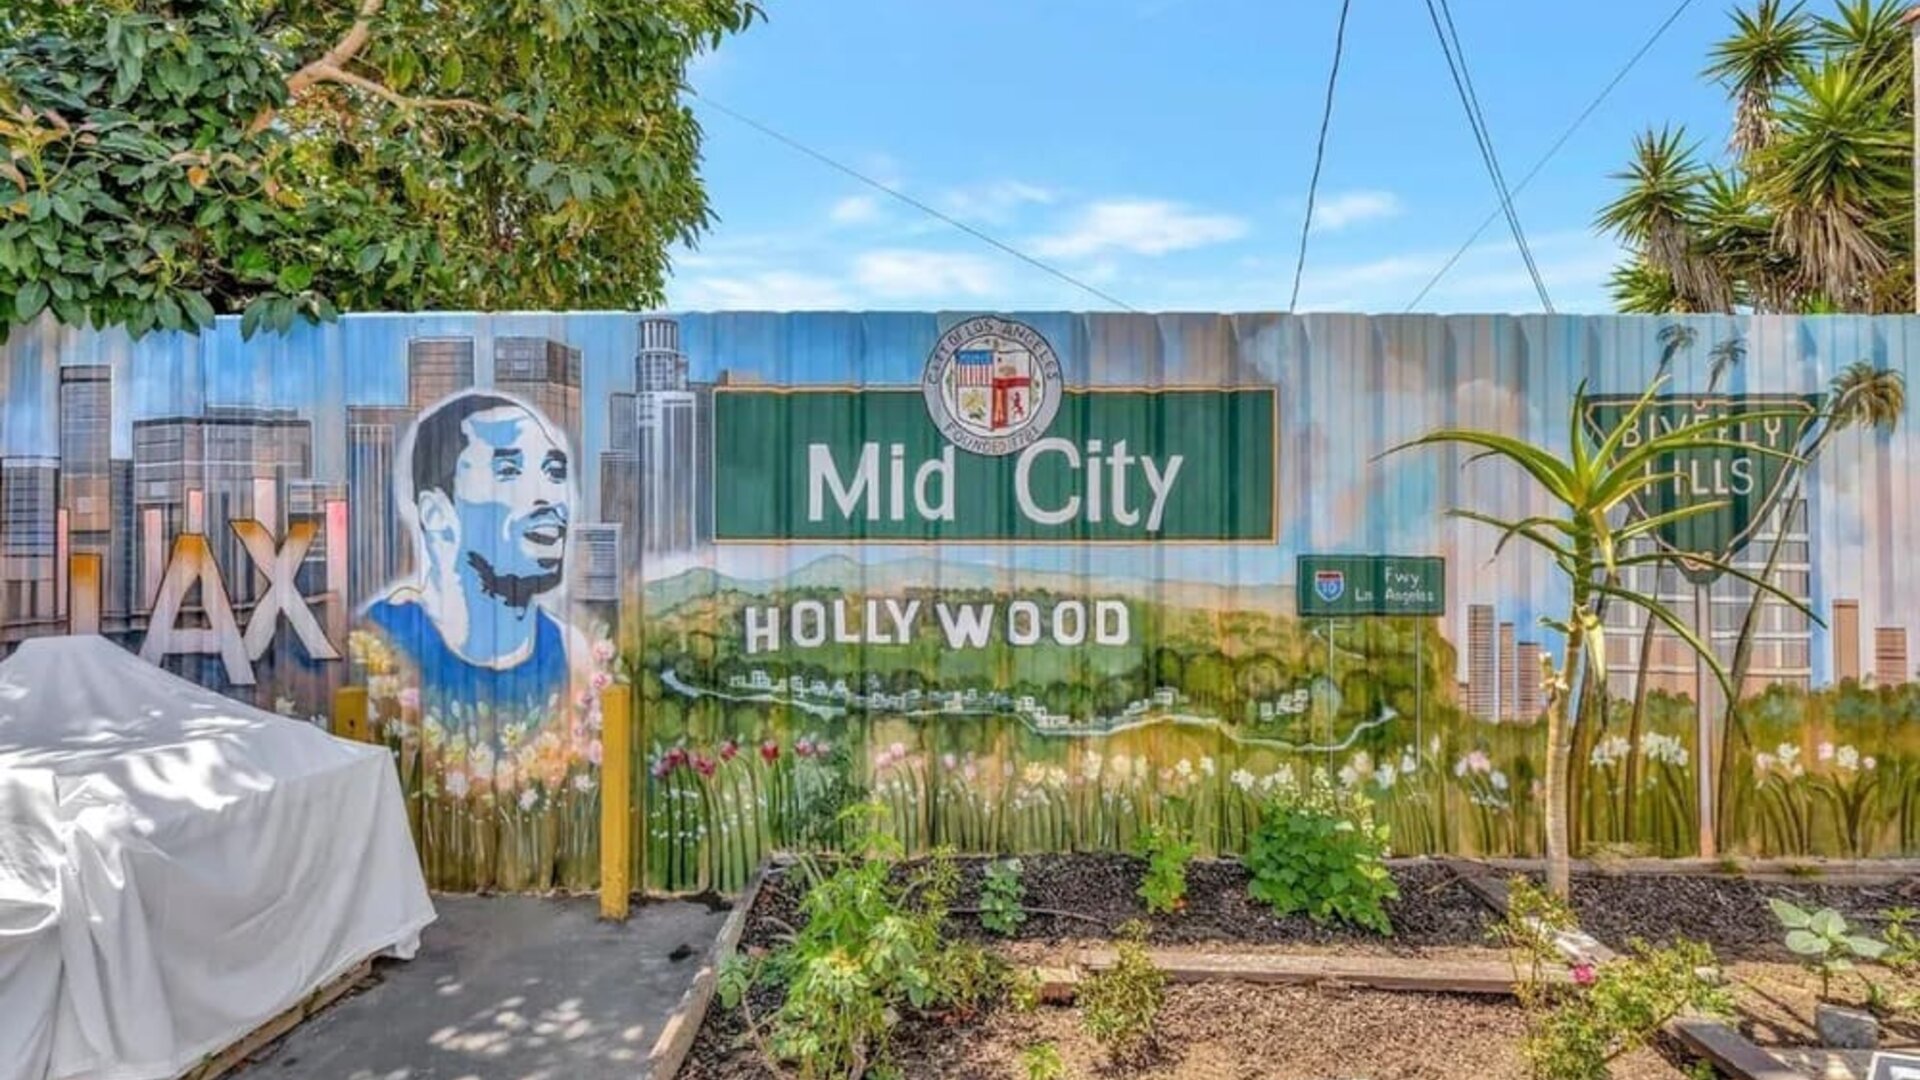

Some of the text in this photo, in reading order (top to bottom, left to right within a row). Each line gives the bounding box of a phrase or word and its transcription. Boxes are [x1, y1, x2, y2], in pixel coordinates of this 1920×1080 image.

[965, 321, 993, 337] LOS
[807, 436, 1184, 531] Mid City
[1321, 581, 1338, 595] 10
[1354, 587, 1373, 602] Lo
[744, 599, 1130, 654] HOLLYWOOD
